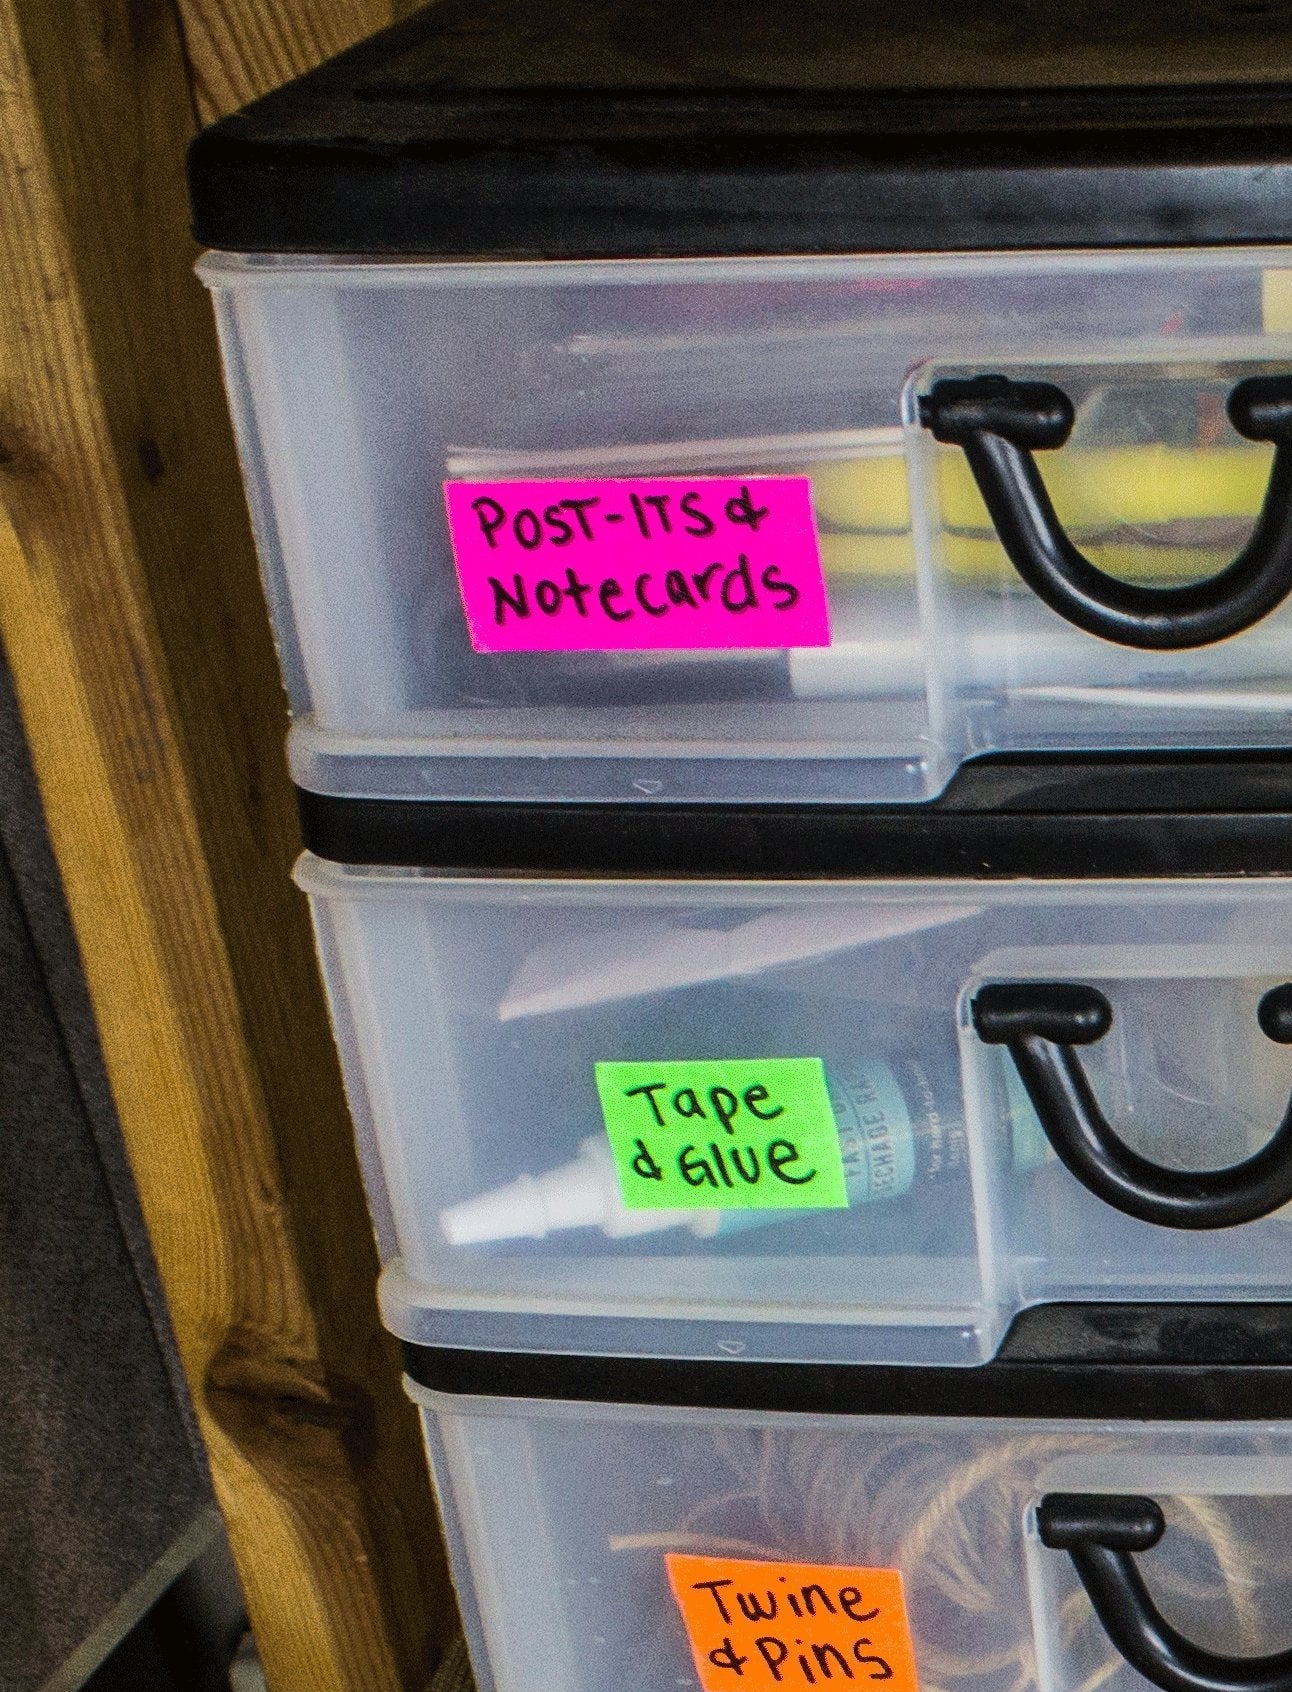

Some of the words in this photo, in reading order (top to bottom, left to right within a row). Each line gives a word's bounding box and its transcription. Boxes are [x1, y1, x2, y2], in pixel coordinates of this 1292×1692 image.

[487, 553, 800, 626] Notecards
[623, 1080, 786, 1135] Tape
[629, 1137, 666, 1182] &
[675, 1137, 819, 1190] Glue
[691, 1575, 881, 1625] Twine
[707, 1636, 749, 1677] &
[754, 1635, 895, 1685] Pins
